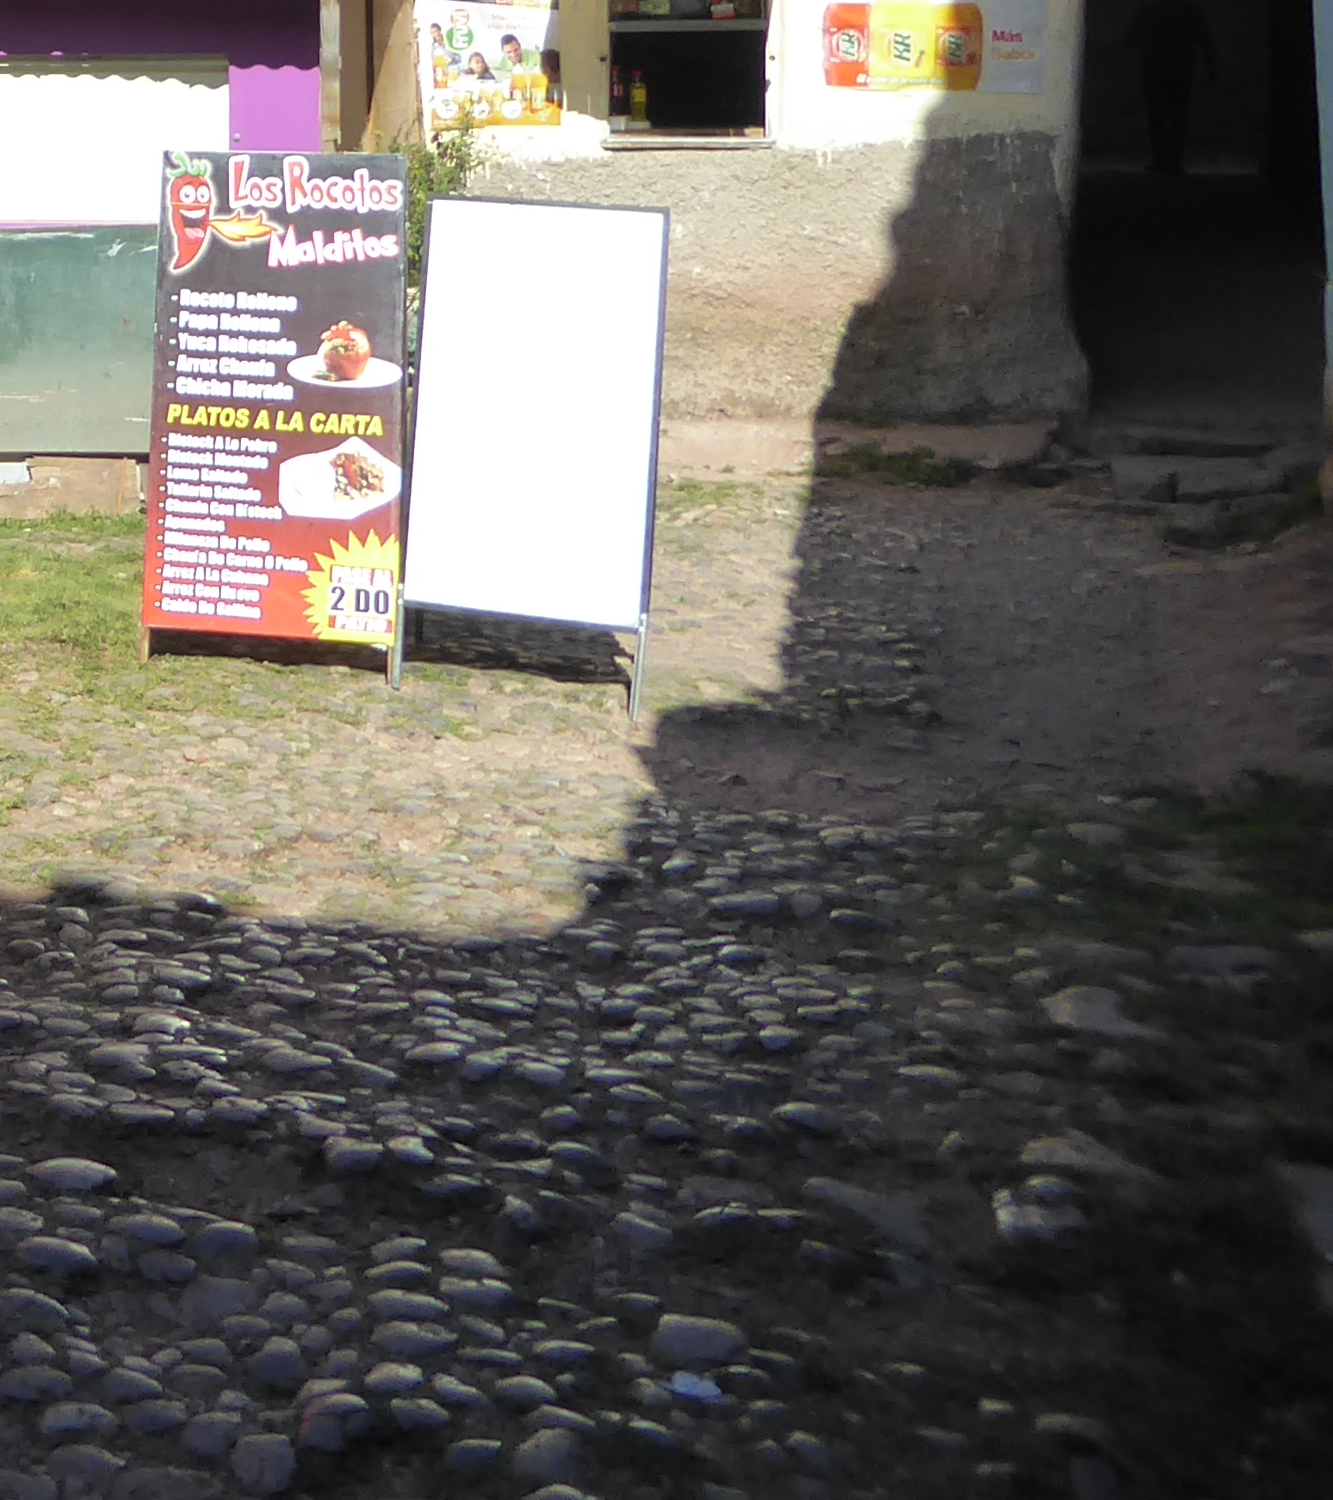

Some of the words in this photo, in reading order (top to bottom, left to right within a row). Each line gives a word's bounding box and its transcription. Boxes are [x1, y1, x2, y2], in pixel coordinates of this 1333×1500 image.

[893, 32, 911, 62] KR
[230, 156, 281, 207] Los
[285, 156, 400, 211] Rocotos
[267, 224, 400, 268] Malditos
[176, 354, 218, 374] Arroz
[175, 375, 232, 397] Chicha
[166, 402, 251, 429] PLATOS
[253, 408, 271, 430] A
[275, 410, 305, 433] LA
[309, 412, 384, 436] CARTA
[214, 435, 225, 450] A
[330, 586, 345, 611] 2
